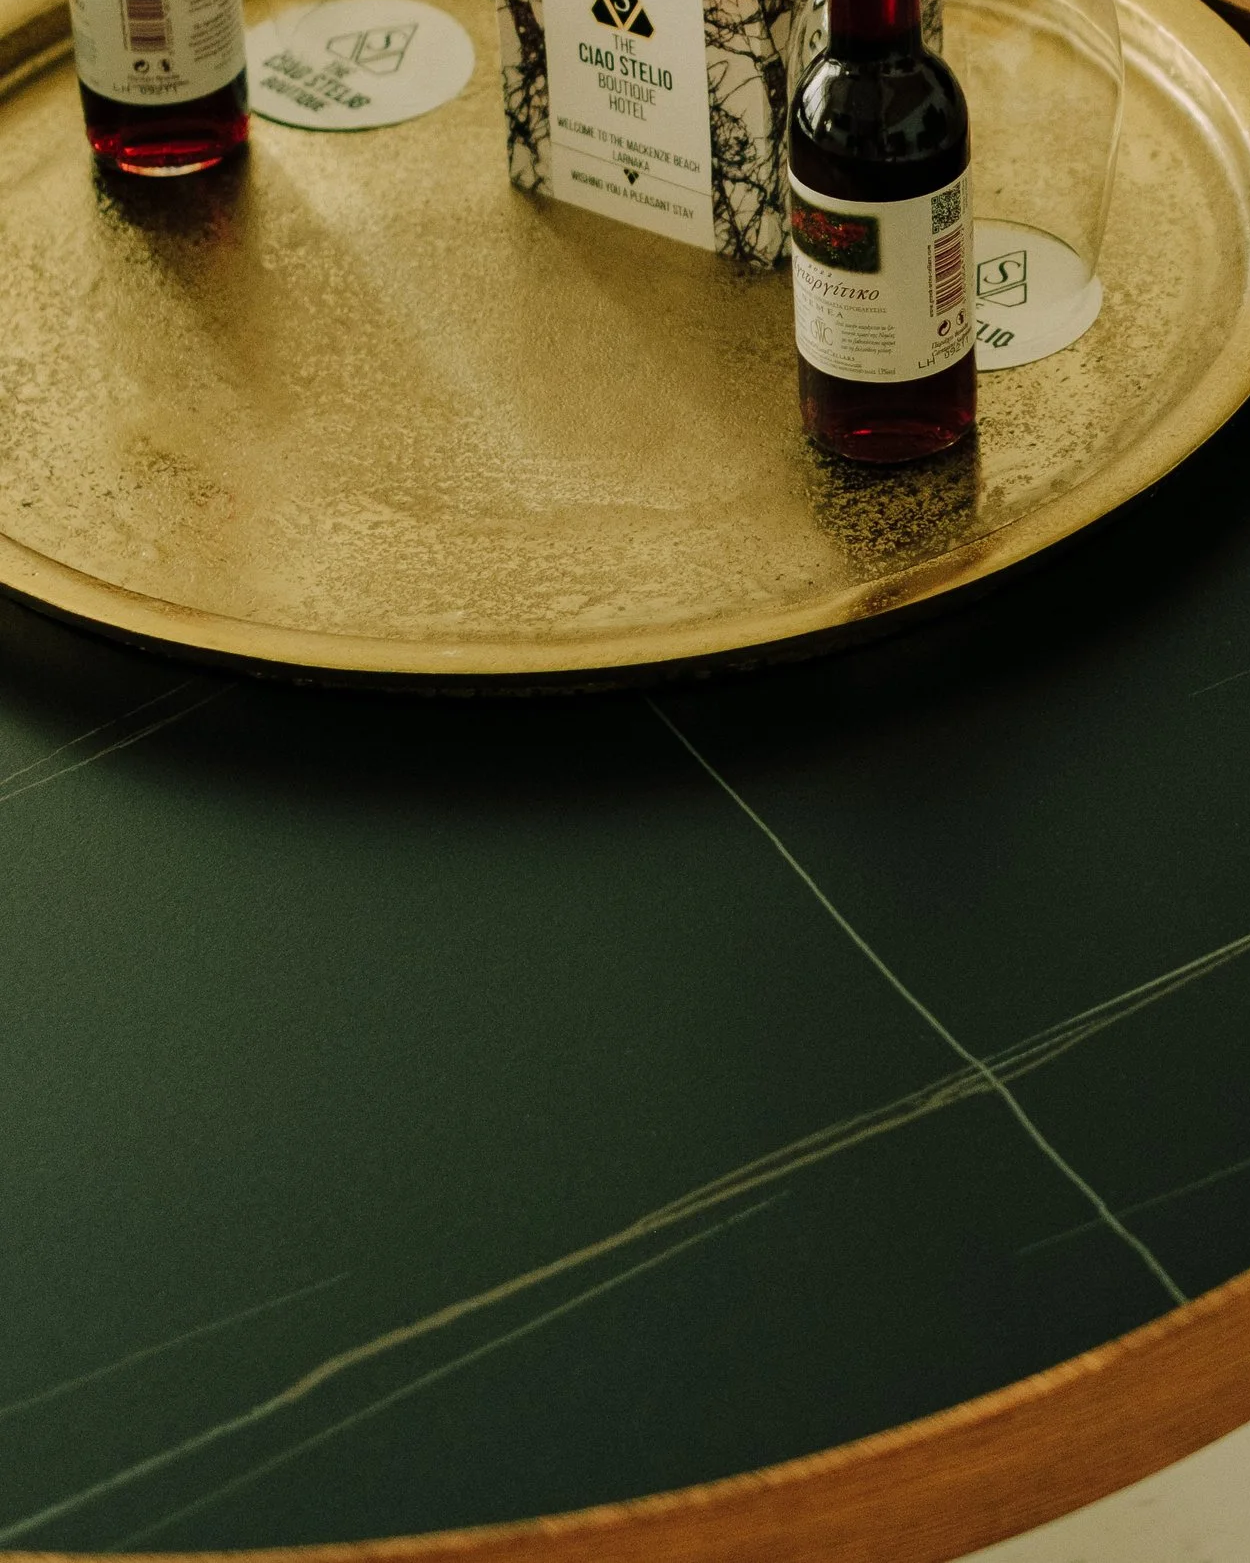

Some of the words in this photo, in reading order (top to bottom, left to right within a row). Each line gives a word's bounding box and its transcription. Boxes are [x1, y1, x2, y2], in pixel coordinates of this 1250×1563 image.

[612, 34, 636, 55] THE
[578, 42, 614, 71] CIAO
[620, 55, 673, 91] STELIO
[598, 72, 657, 106] BOUTIQUE
[609, 94, 648, 121] HOTEL
[557, 115, 594, 137] WELCOME
[598, 129, 608, 142] TO
[610, 133, 624, 147] THE
[626, 139, 670, 164] MACKENZIE
[673, 155, 700, 173] BEACH
[571, 169, 604, 189] WISHING
[606, 183, 621, 197] YOU
[630, 190, 670, 213] PLEASANT
[672, 204, 694, 220] STAY
[918, 355, 936, 369] LH
